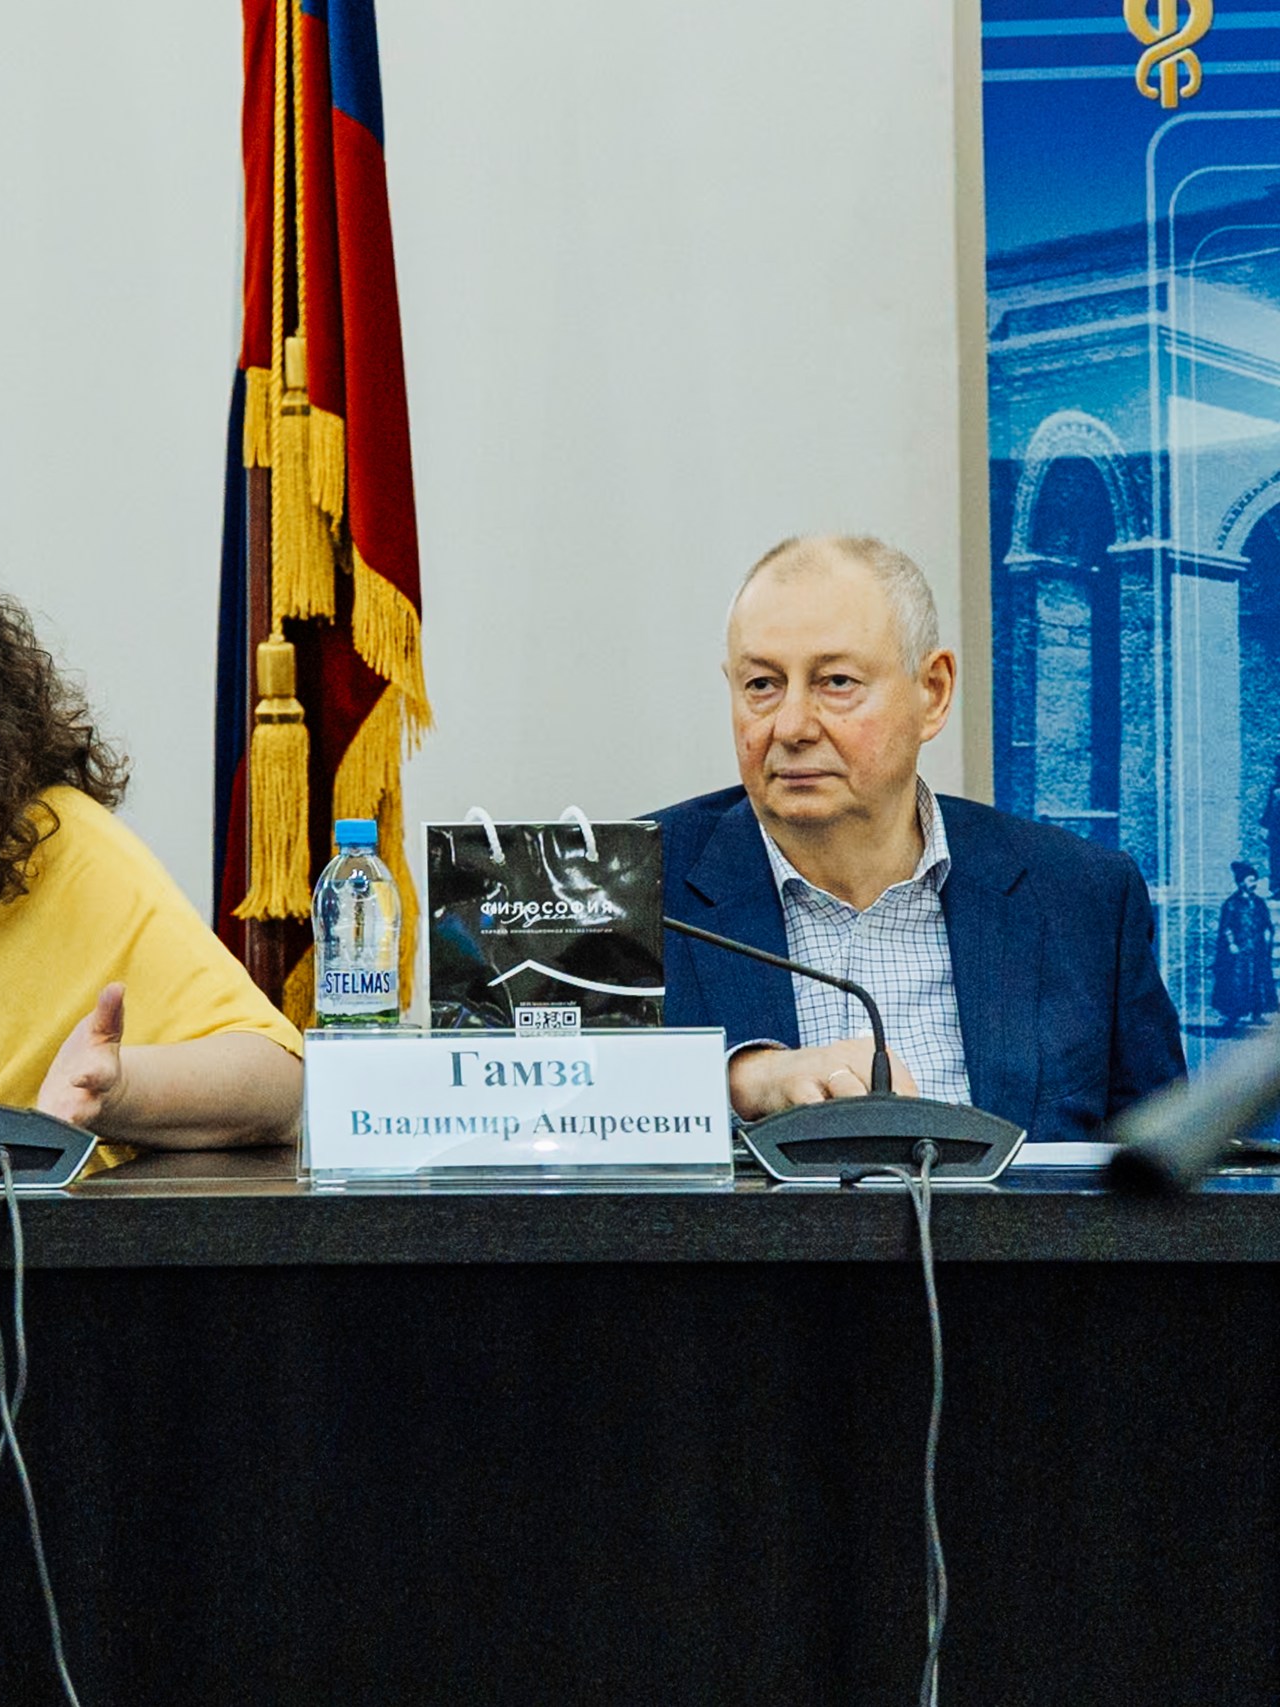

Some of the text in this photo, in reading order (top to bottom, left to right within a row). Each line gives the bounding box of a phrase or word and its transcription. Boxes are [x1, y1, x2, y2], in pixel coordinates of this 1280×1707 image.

[480, 900, 615, 915] ФИЛОСОФИЯ
[325, 972, 390, 994] STELMAS
[447, 1050, 595, 1087] Гамза
[350, 1108, 713, 1141] Владимир Андреевич
